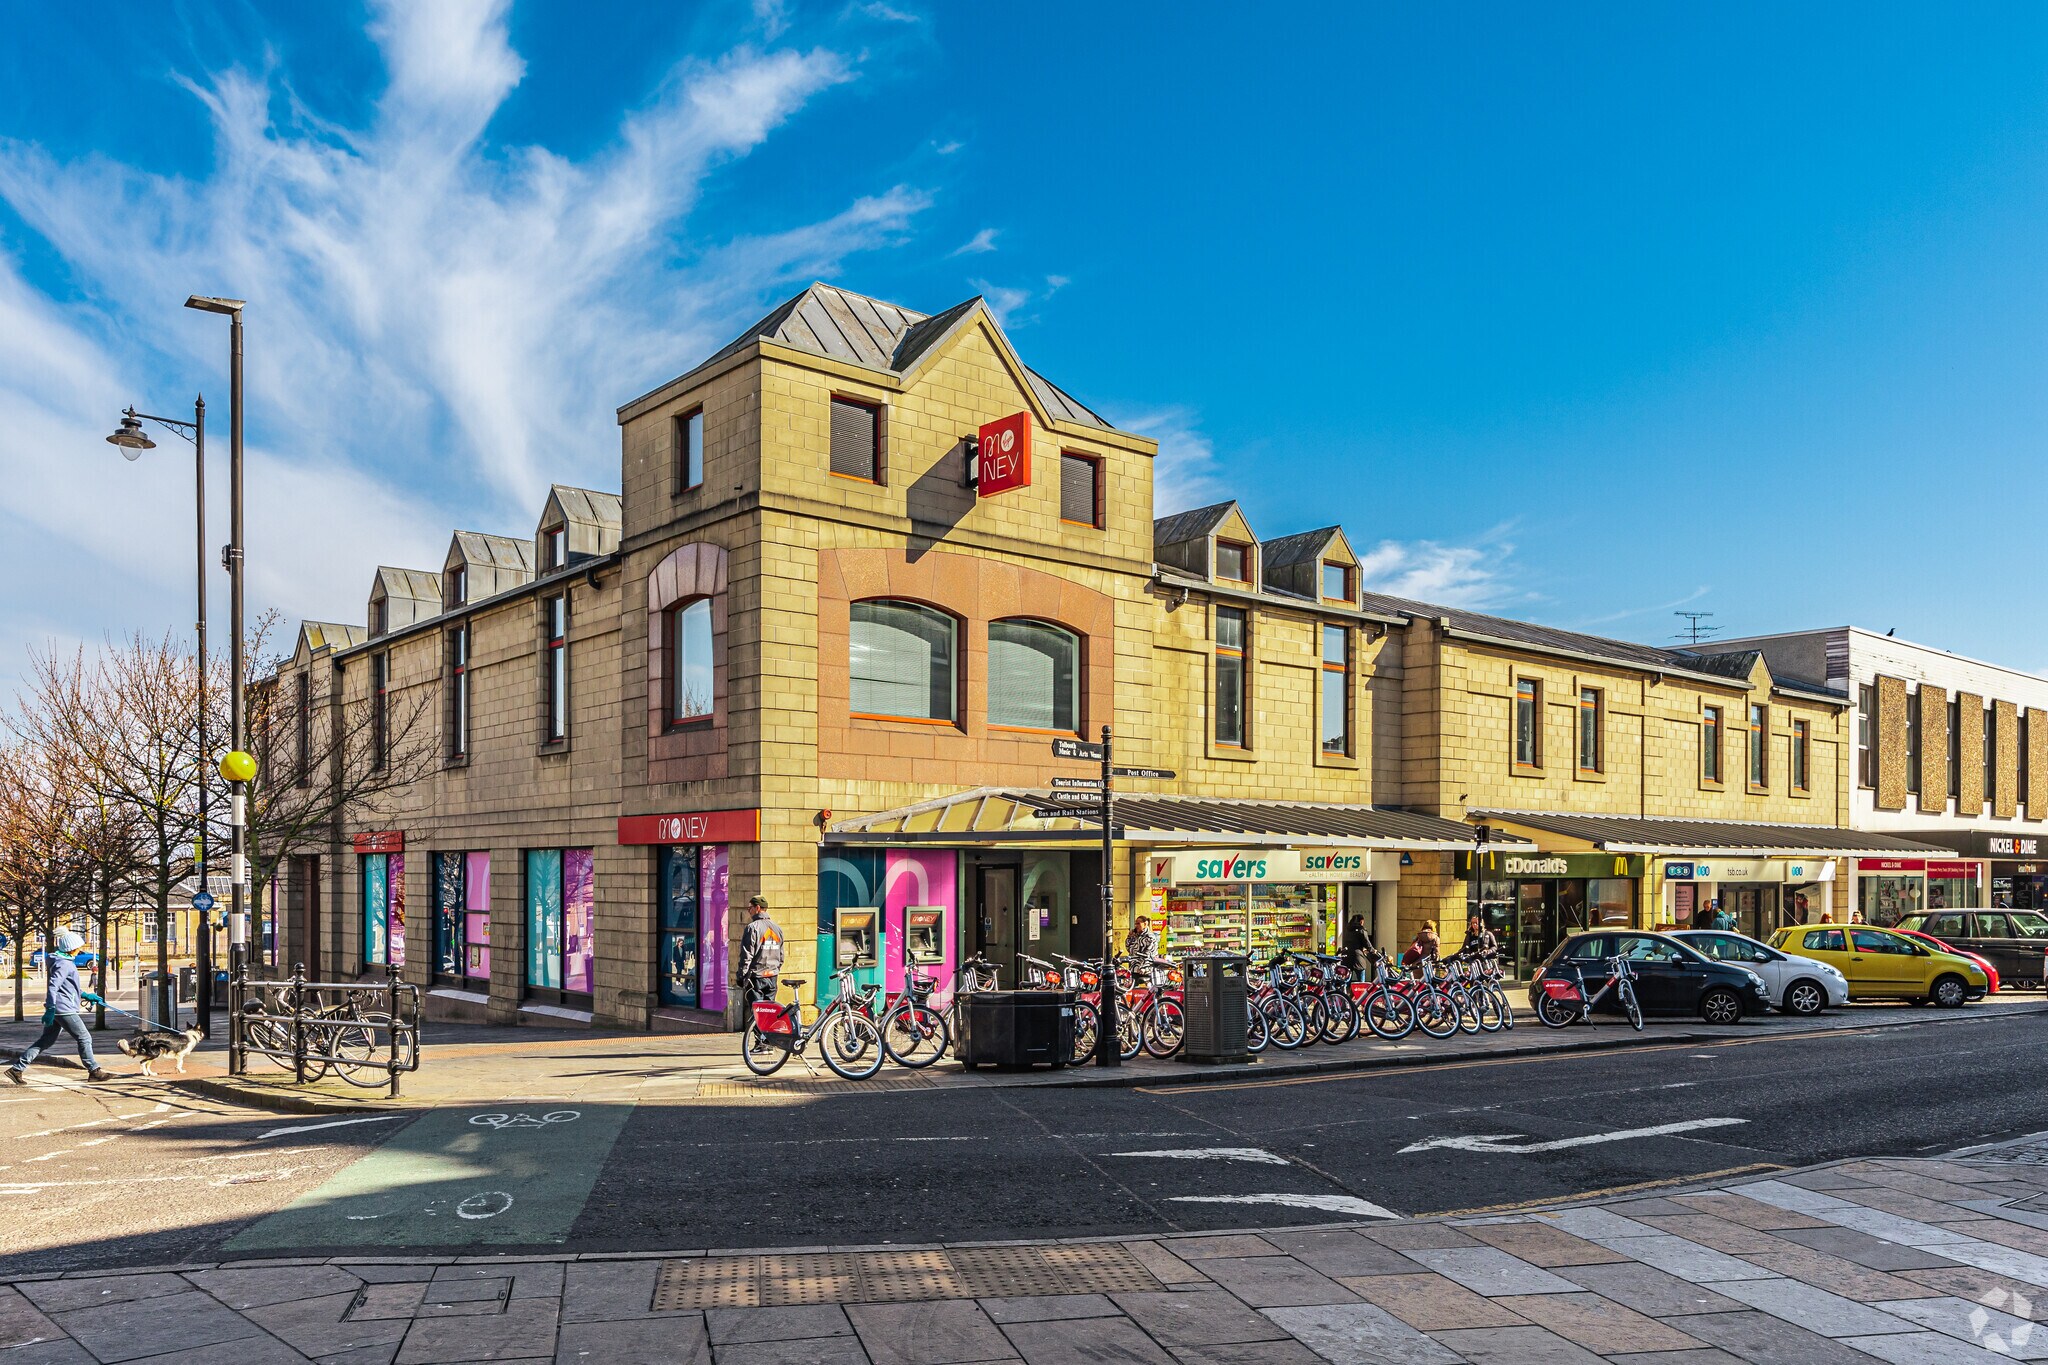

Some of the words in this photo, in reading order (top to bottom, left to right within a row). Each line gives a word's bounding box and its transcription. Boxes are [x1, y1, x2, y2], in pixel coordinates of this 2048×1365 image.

[1058, 741, 1077, 749] Tolbooth
[1058, 748, 1071, 756] Music
[1078, 750, 1089, 758] Arts
[1141, 769, 1159, 777] Office
[1055, 778, 1071, 786] Tourist
[1056, 792, 1071, 800] Castle
[658, 816, 708, 840] MONEY
[1989, 837, 2014, 854] NICKEL
[2014, 838, 2020, 854] &
[2020, 839, 2037, 855] DIME
[1305, 851, 1361, 869] savers
[1196, 852, 1267, 879] savers
[1505, 857, 1568, 874] cDonald's
[1668, 865, 1691, 876] TSB
[1727, 867, 1748, 876] tsb.co.uk
